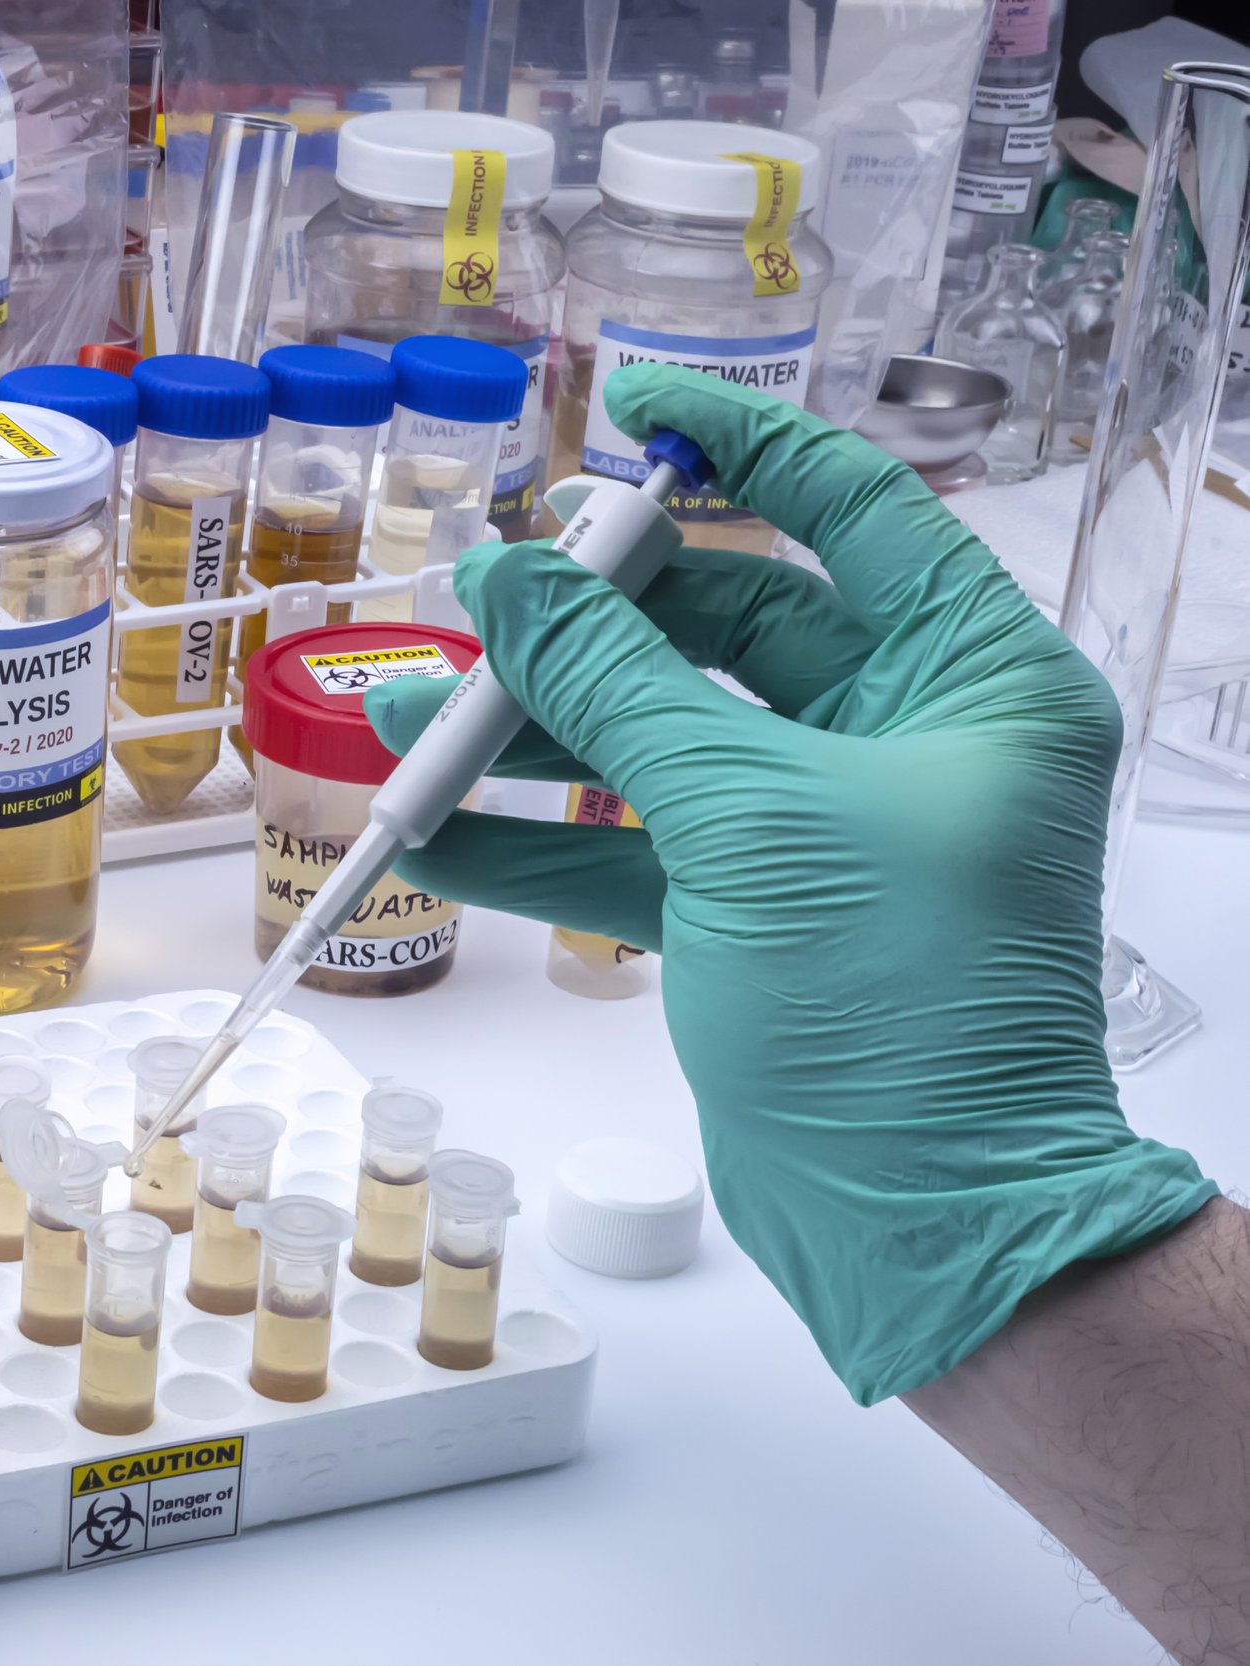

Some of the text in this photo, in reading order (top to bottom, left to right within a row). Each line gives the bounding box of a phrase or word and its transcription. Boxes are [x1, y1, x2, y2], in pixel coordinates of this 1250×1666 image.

[464, 155, 486, 236] INFECTION
[499, 441, 521, 460] 020
[685, 497, 703, 509] OF
[285, 523, 303, 536] 40
[281, 553, 299, 568] 35
[184, 517, 224, 684] SARS-OV-2
[335, 649, 434, 665] CAUTION
[382, 665, 427, 675] Danger
[25, 736, 32, 753] /
[37, 726, 74, 751] 2020
[59, 743, 102, 777] TEST
[2, 788, 73, 816] INFECTION
[315, 919, 458, 969] ARS-COV-2
[108, 1444, 236, 1483] CAUTION
[152, 1486, 233, 1512] Danger of
